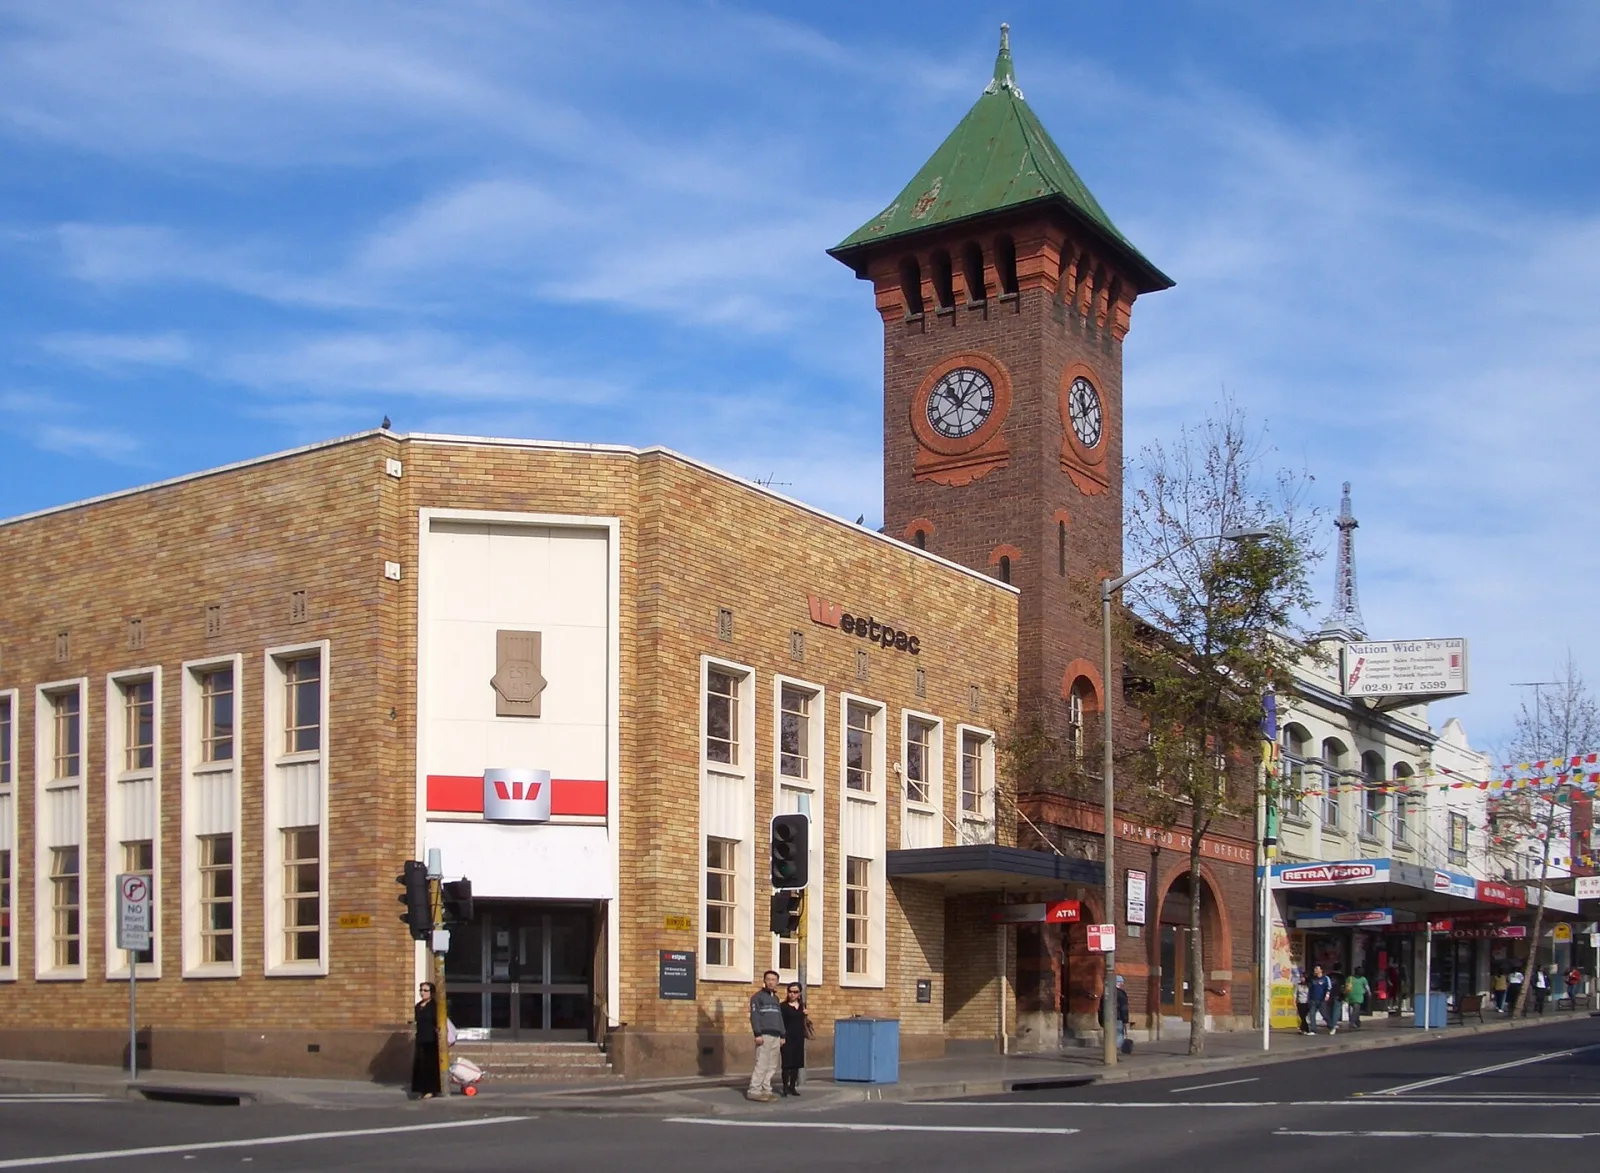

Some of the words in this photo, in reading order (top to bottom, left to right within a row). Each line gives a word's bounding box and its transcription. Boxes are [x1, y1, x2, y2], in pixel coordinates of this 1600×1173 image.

[807, 594, 921, 655] Westpac
[1349, 645, 1388, 655] Nation
[1393, 643, 1422, 652] Wide
[1426, 642, 1441, 650] Pty
[1362, 683, 1392, 692] (02-9)
[1397, 682, 1414, 690] 747
[1420, 681, 1447, 690] 5599
[1181, 835, 1207, 851] POT
[1213, 843, 1250, 860] OFFICE
[127, 904, 143, 913] NO
[1056, 909, 1076, 918] ATM
